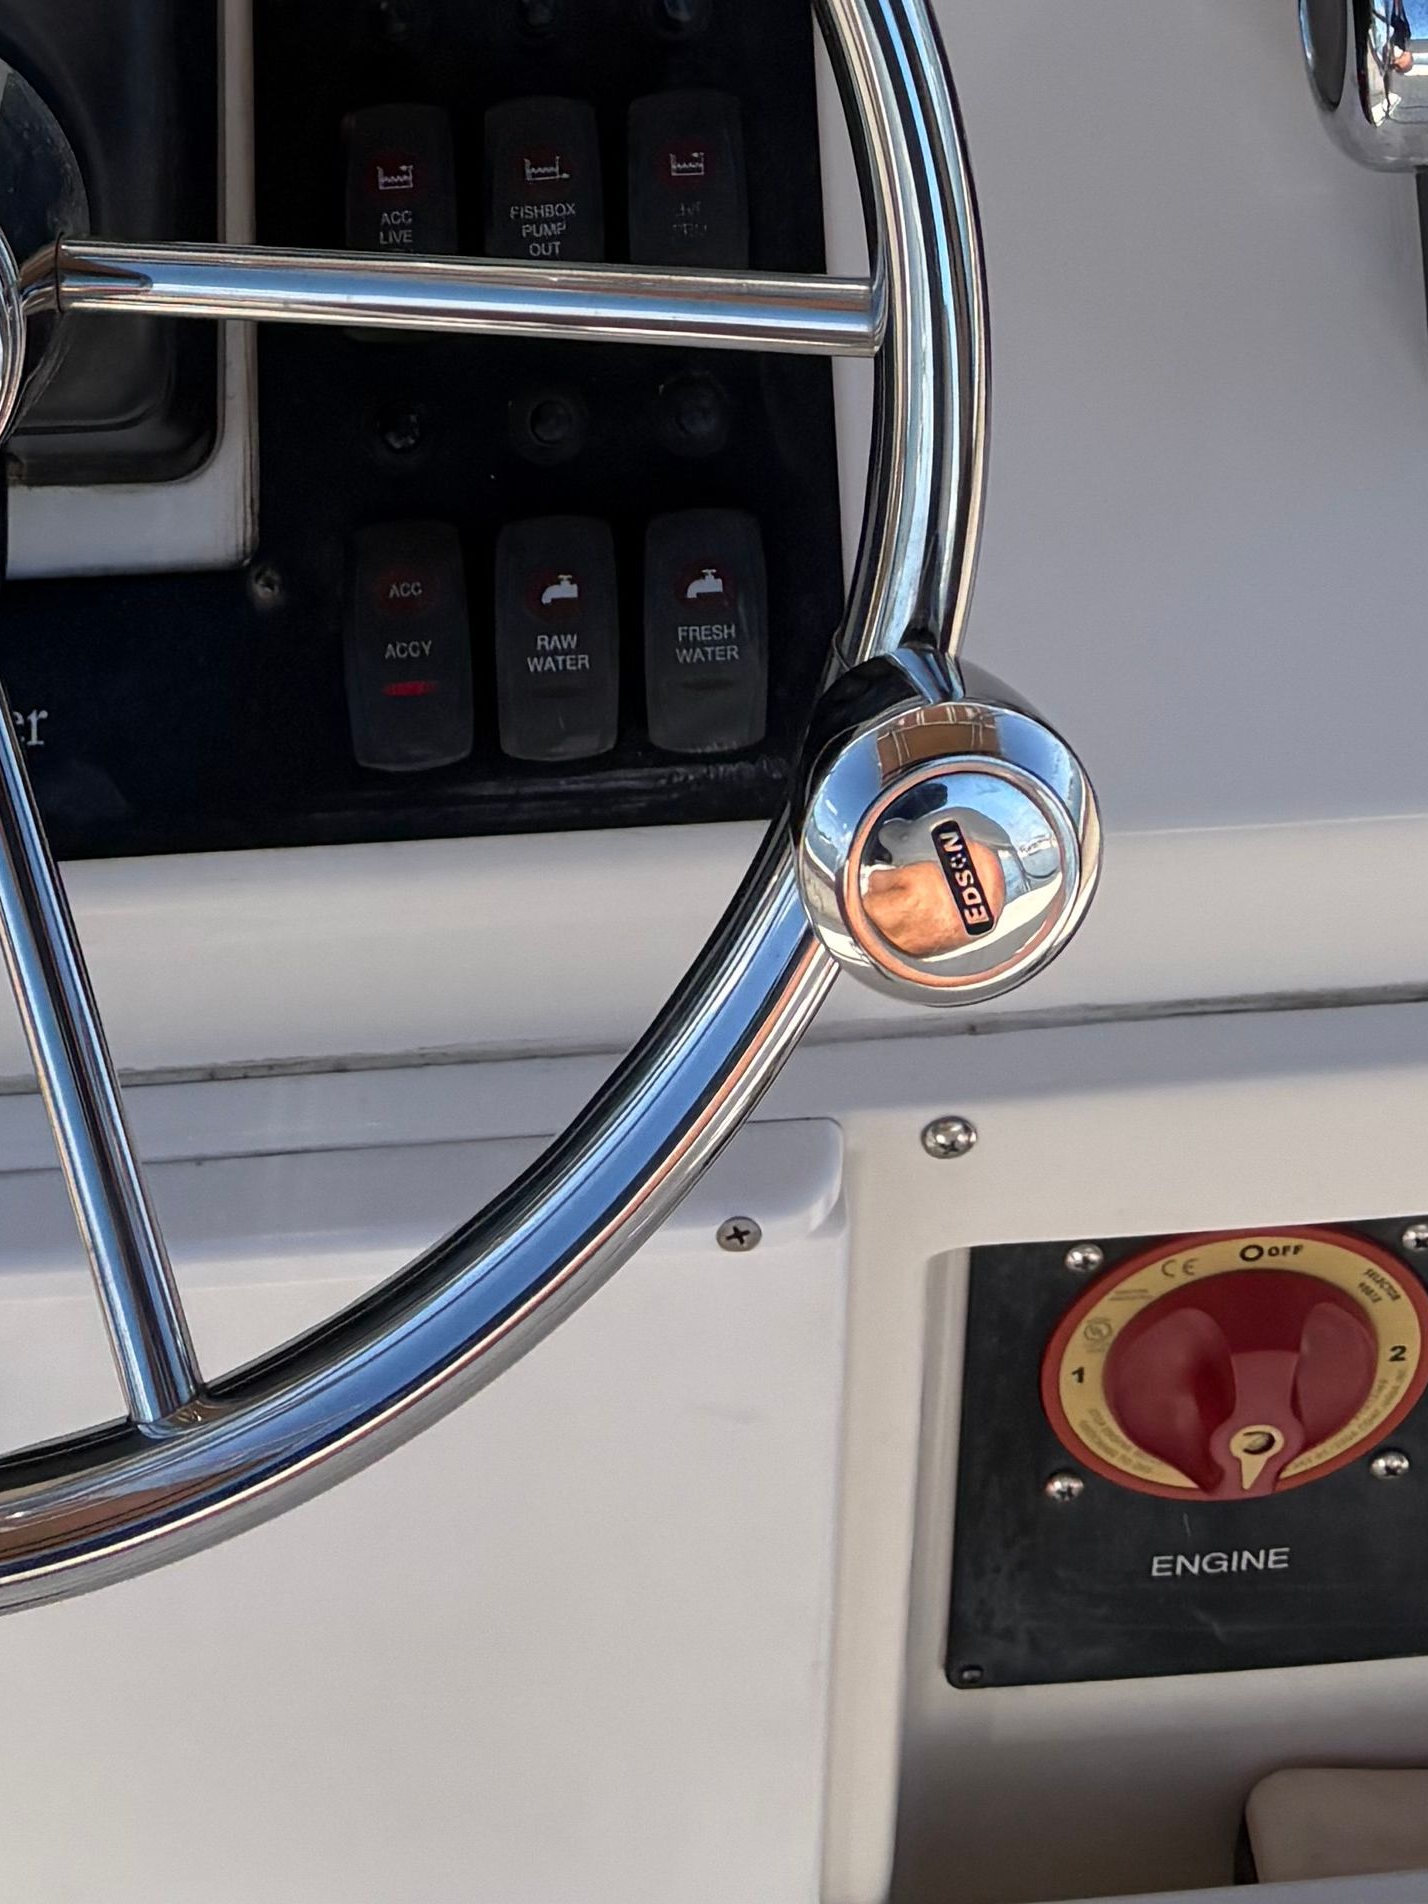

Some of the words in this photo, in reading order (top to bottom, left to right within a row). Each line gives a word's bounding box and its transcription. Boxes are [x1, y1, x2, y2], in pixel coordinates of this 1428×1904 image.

[380, 209, 413, 226] ACC
[509, 202, 577, 220] FISHBOX
[379, 230, 414, 245] LIVE
[521, 221, 567, 239] PUMP
[528, 241, 561, 257] OUT
[389, 581, 423, 598] ACC
[535, 633, 578, 652] RAW
[677, 624, 736, 643] FRESH
[384, 640, 433, 660] ACCY
[675, 645, 740, 664] WATER
[527, 653, 590, 674] WATER
[1267, 1243, 1304, 1258] OFF
[1388, 1345, 1407, 1363] 2
[1070, 1366, 1085, 1384] 1
[1149, 1546, 1291, 1577] ENGINE
